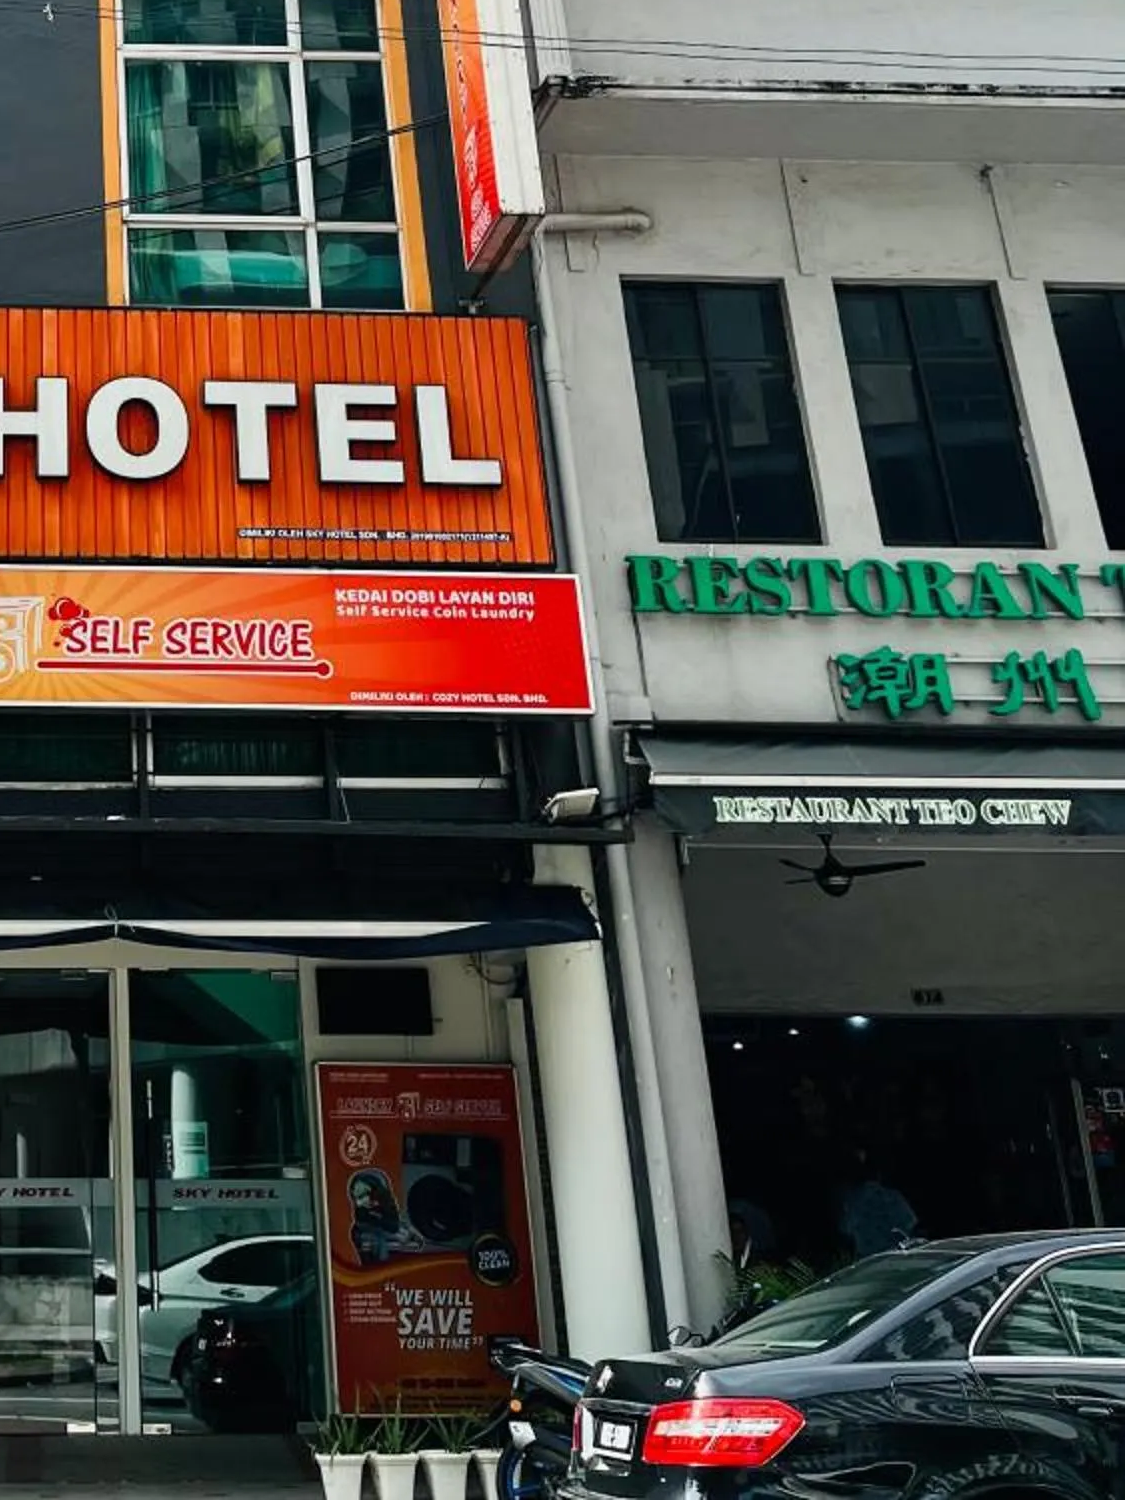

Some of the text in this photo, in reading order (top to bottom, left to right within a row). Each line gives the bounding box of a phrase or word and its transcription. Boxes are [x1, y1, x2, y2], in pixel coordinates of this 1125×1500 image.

[625, 555, 1085, 621] RESTORAN
[335, 589, 535, 606] KEDAI DOBI LAYAN DIRI
[336, 605, 535, 621] Self Service Coin Laundry
[65, 617, 315, 658] SELF SERVICE
[433, 692, 459, 703] COZY
[461, 692, 495, 703] HOTEL
[713, 796, 1072, 826] RESTAURANT TEO CHEW
[347, 1133, 369, 1154] 24
[11, 1187, 75, 1198] HOTEL
[172, 1187, 279, 1199] SKY HOTEL
[429, 1288, 474, 1306] WILL
[397, 1307, 474, 1335] SAVE
[399, 1336, 434, 1349] YOUR
